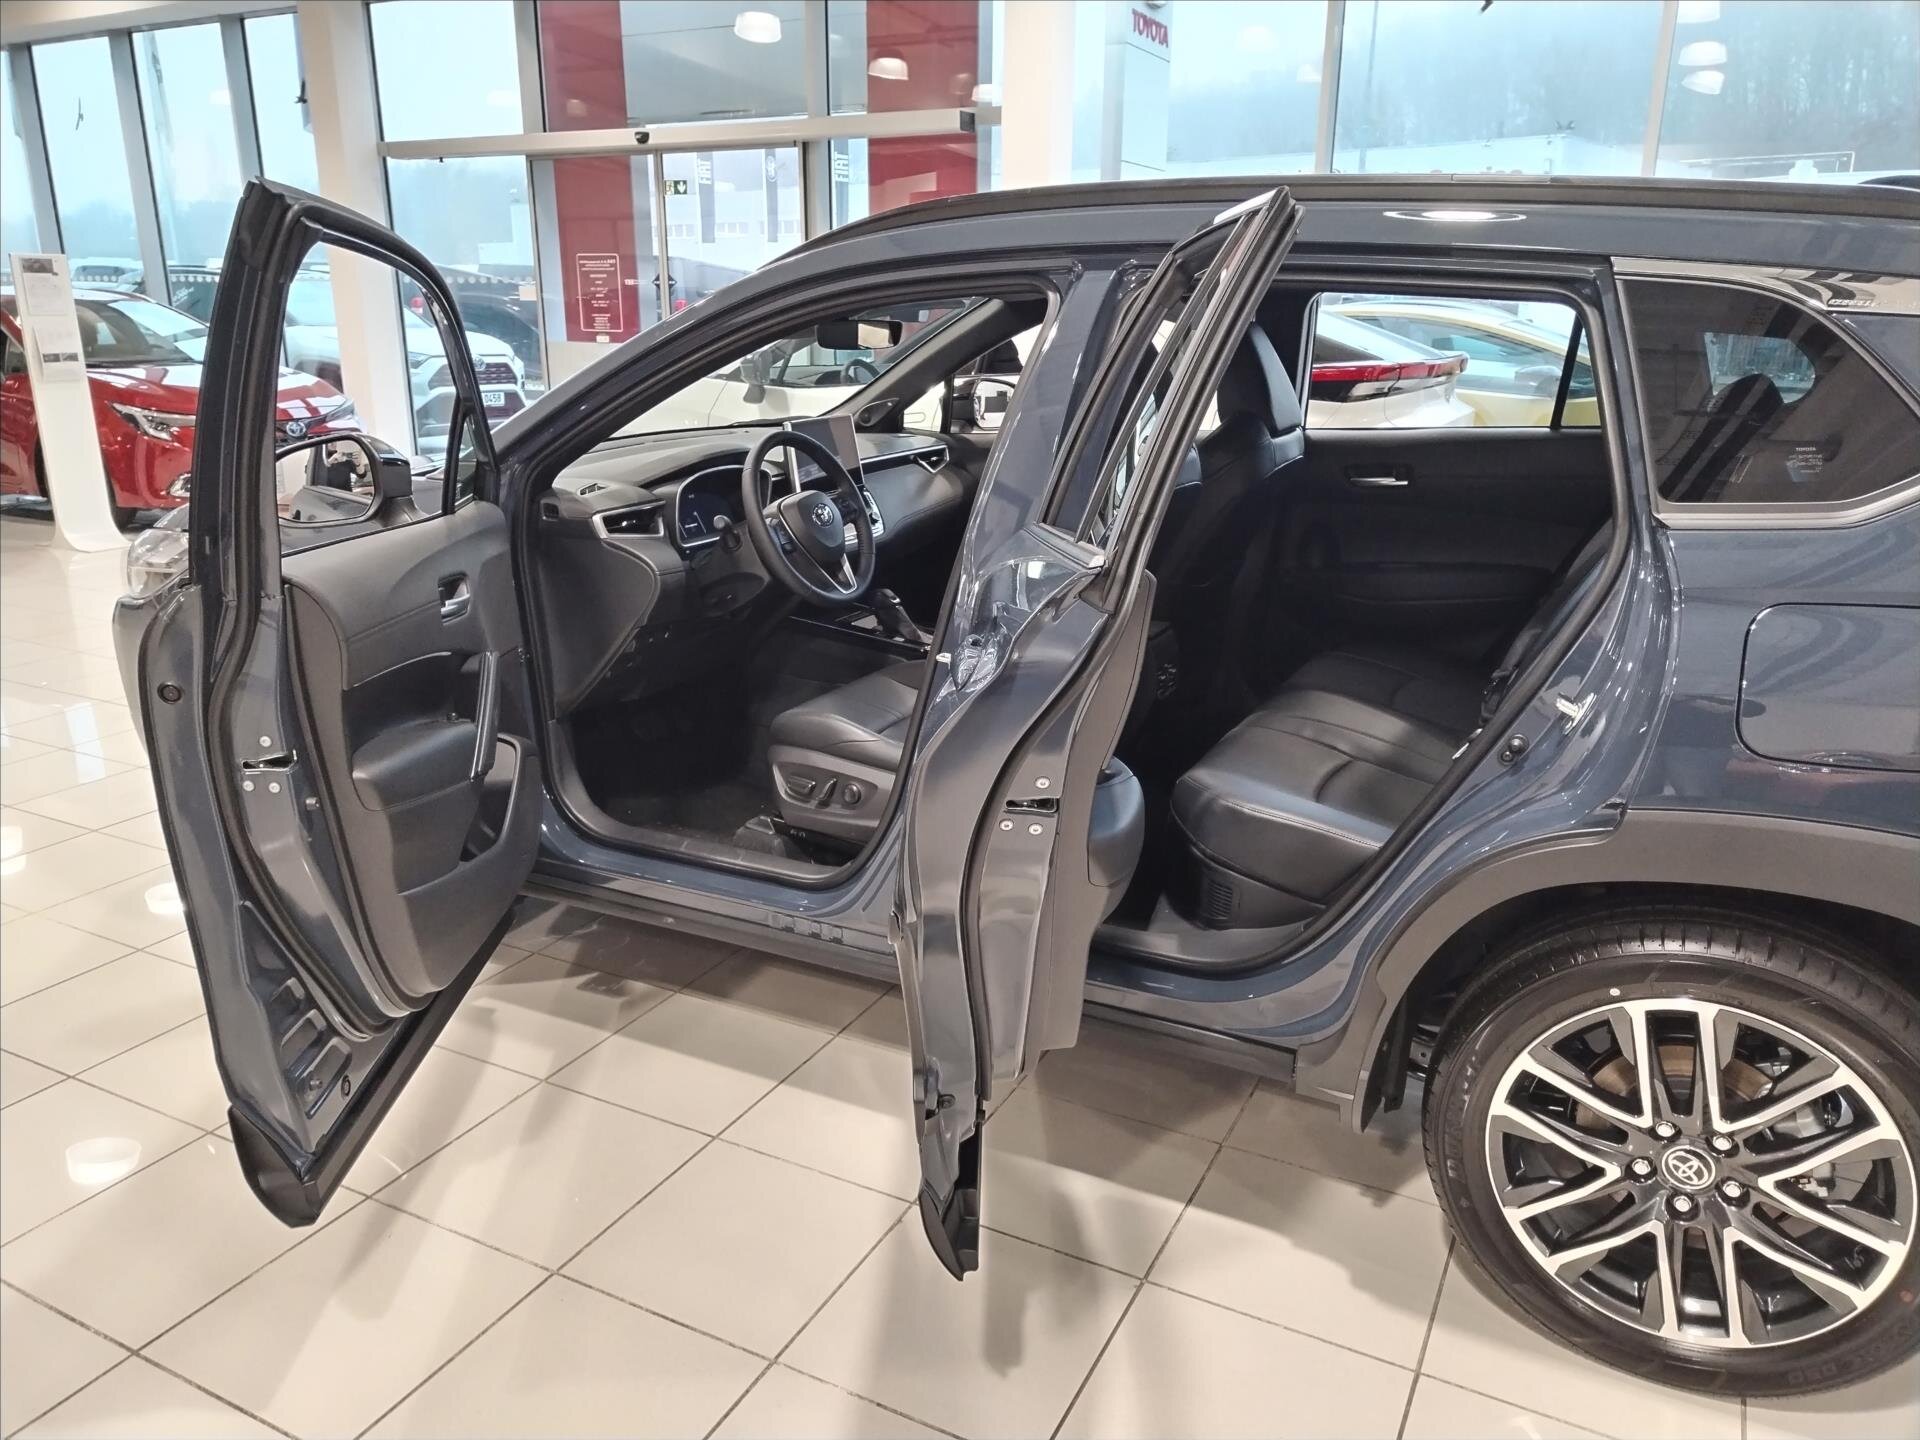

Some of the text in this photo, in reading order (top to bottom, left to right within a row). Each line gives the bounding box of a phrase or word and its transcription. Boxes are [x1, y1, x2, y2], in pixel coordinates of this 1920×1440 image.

[1131, 8, 1169, 48] TOYOTA
[698, 159, 713, 185] FIAT
[833, 152, 849, 182] FIAT
